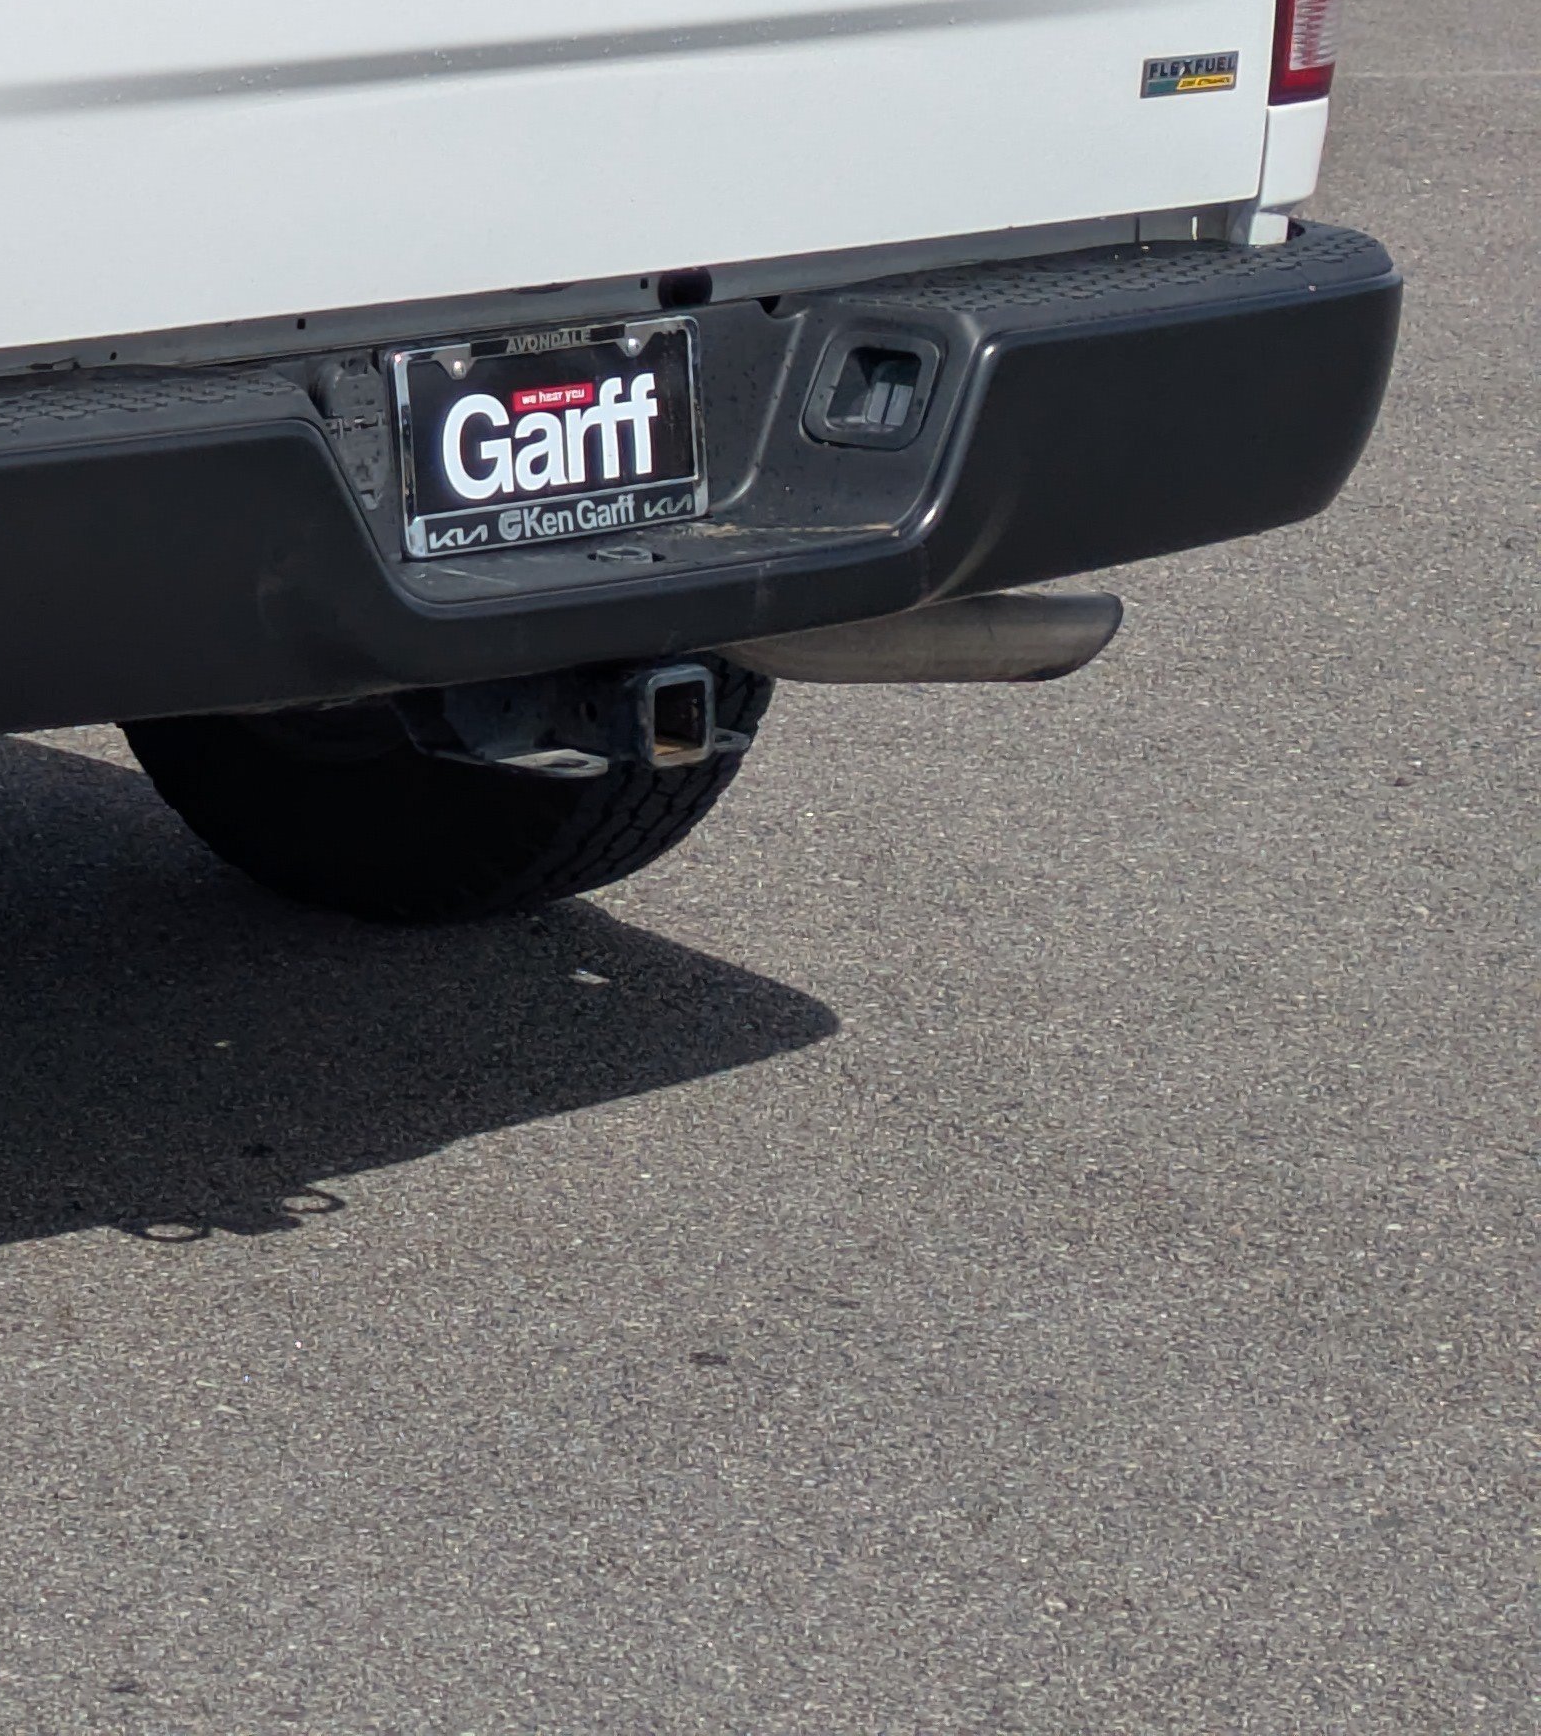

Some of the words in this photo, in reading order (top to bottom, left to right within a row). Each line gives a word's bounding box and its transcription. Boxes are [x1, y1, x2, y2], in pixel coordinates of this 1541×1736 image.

[505, 329, 591, 354] AVONDALE
[539, 387, 563, 403] hear
[566, 387, 585, 402] you
[443, 373, 658, 500] Garff
[524, 508, 574, 538] Ken
[577, 493, 636, 531] Garff
